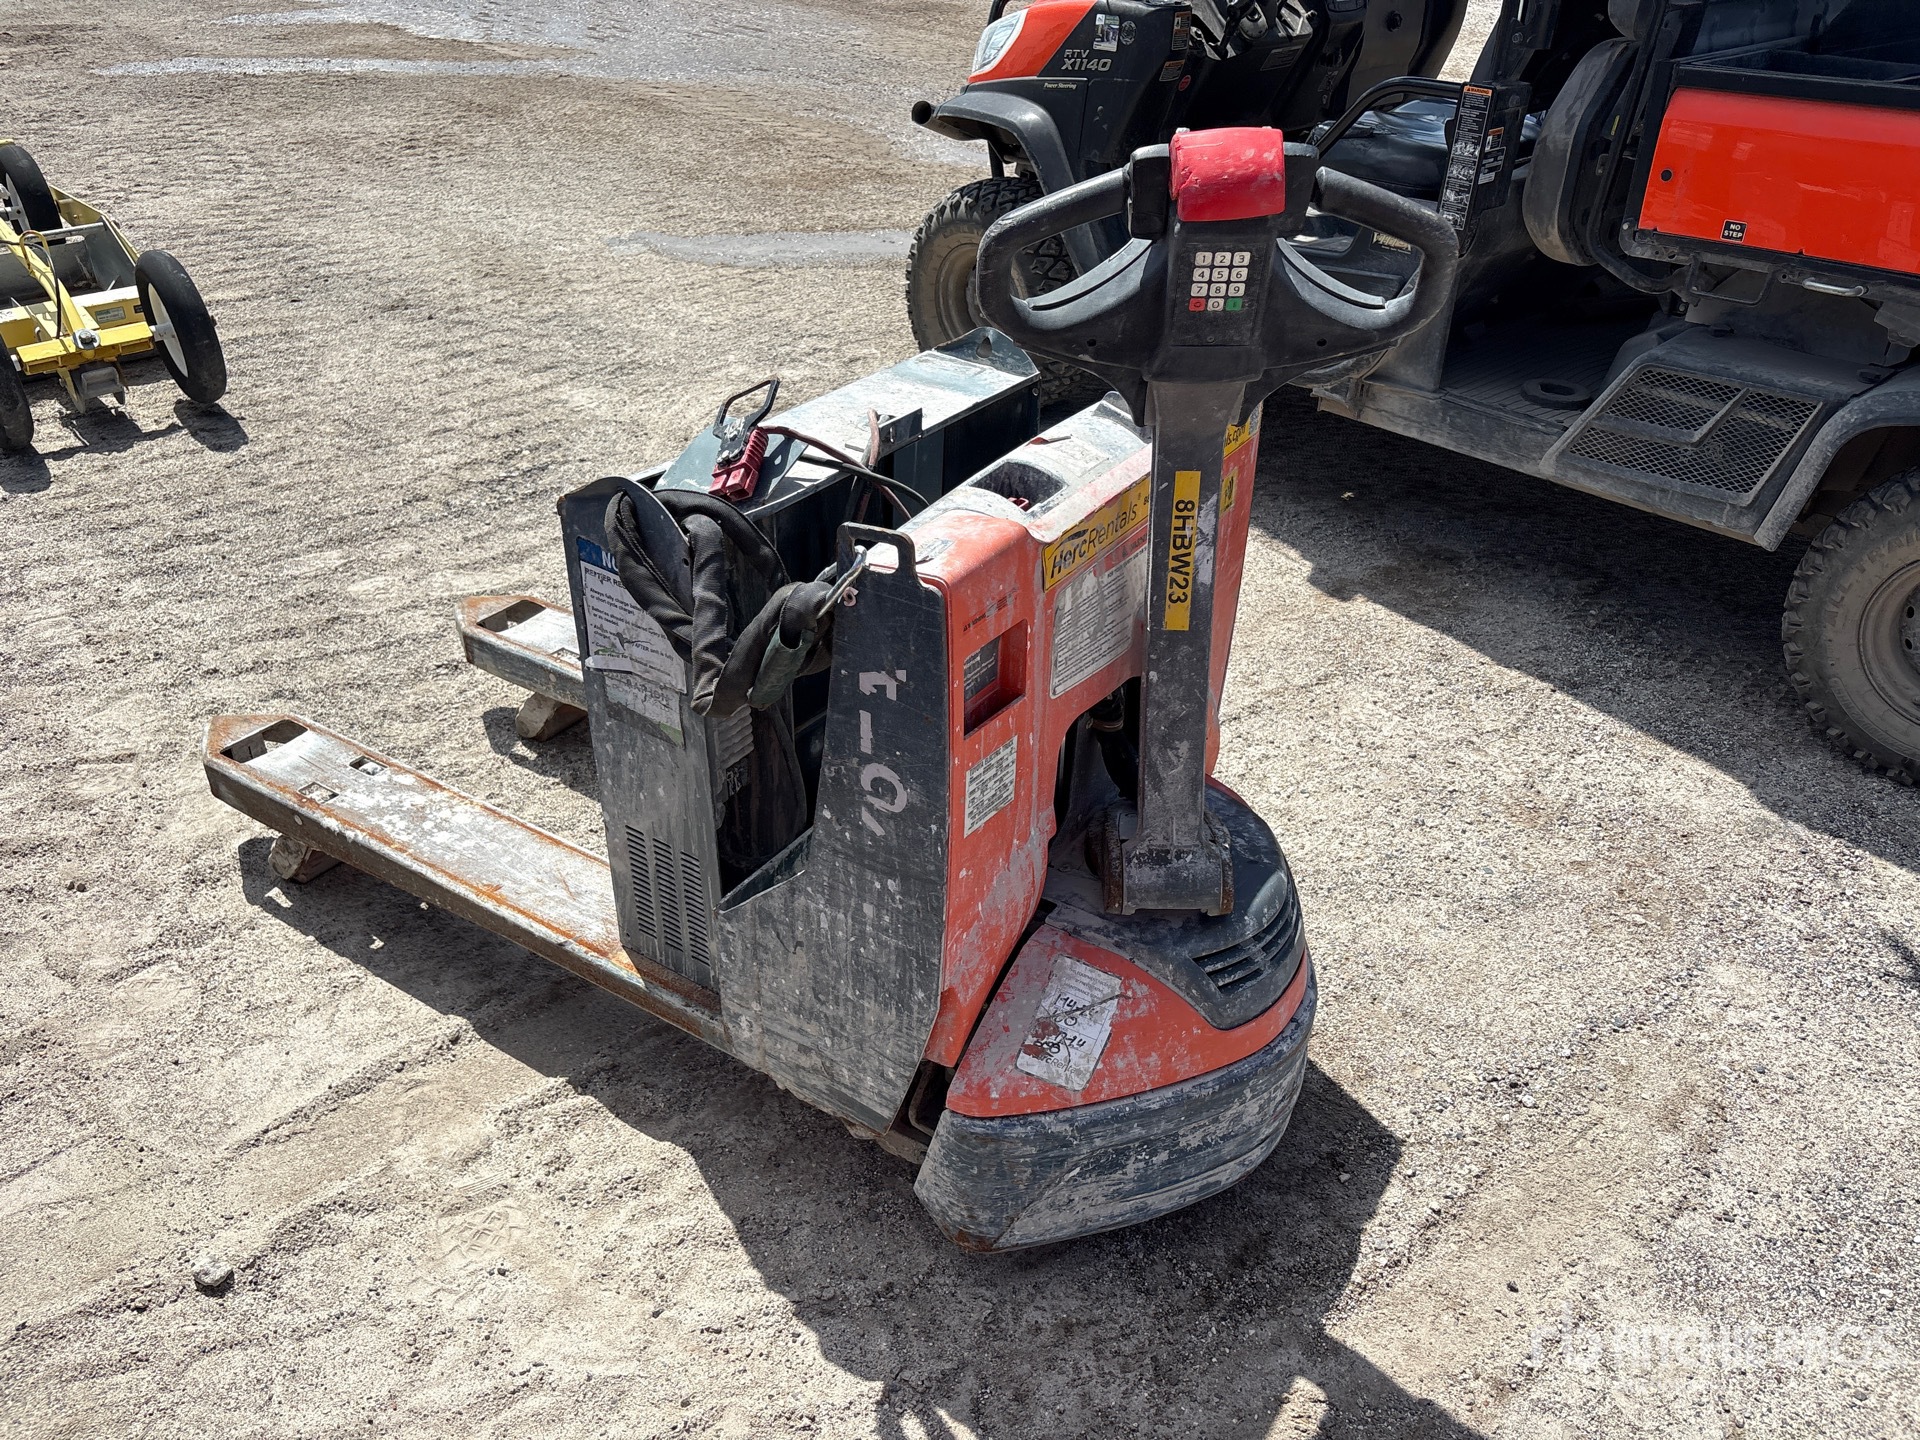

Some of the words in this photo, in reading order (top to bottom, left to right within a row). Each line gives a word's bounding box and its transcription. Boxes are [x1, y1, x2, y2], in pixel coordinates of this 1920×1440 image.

[1064, 49, 1089, 57] RTV
[1061, 58, 1112, 71] X1140
[1724, 230, 1743, 238] STEP
[1050, 501, 1138, 579] HercRentals
[1167, 499, 1196, 605] 8HBW23
[590, 588, 604, 598] Always
[604, 593, 615, 602] fully
[615, 597, 629, 608] charge
[634, 642, 650, 653] AFTER
